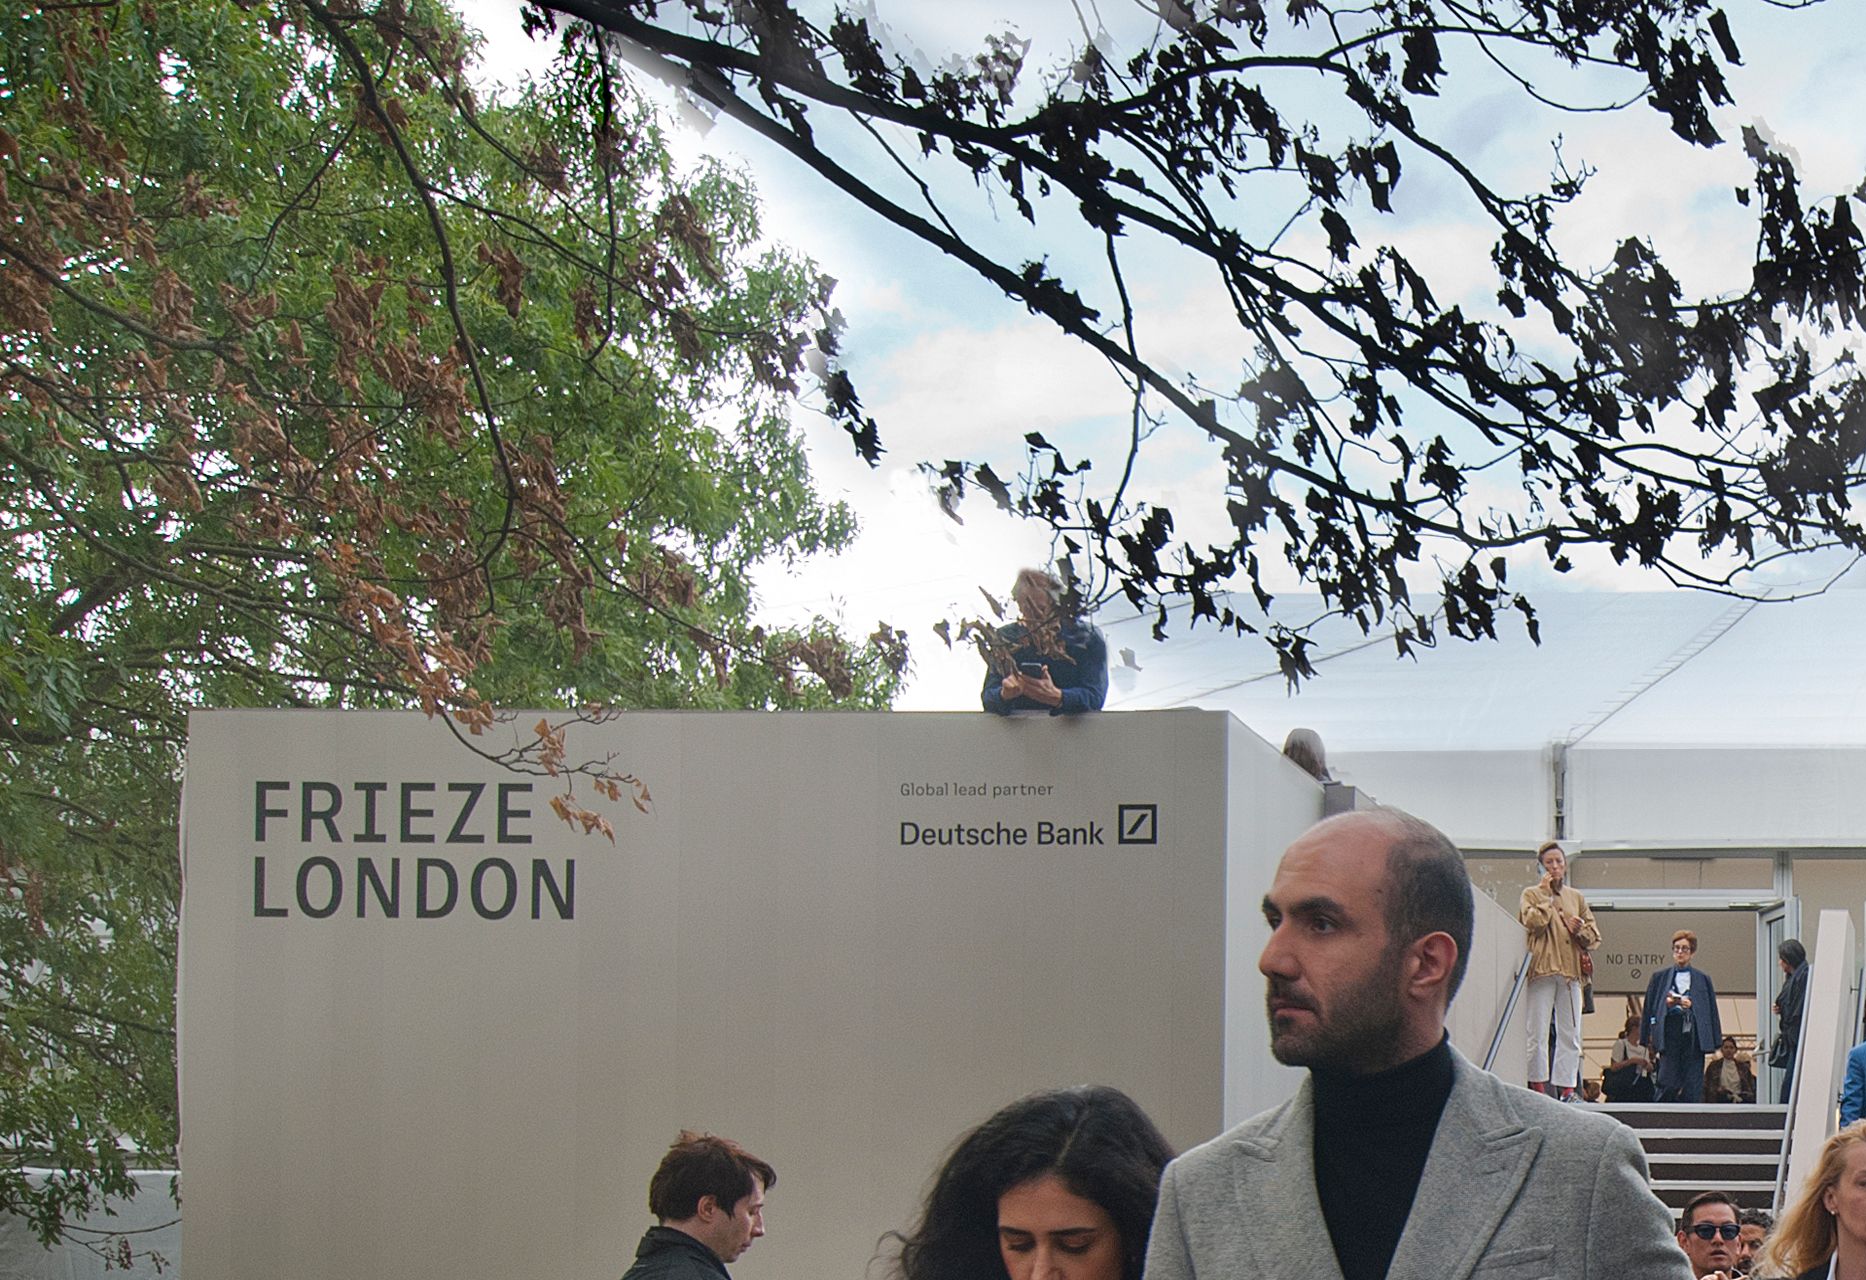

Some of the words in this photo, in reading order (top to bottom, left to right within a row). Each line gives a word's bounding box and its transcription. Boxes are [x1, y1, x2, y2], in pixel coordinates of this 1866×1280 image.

[900, 783, 949, 797] Global
[953, 783, 987, 797] lead
[992, 784, 1054, 799] partner
[254, 780, 534, 844] FRIEZE
[900, 821, 1028, 846] Deutsche
[1037, 821, 1104, 846] Bank
[254, 855, 576, 920] LONDON
[1606, 954, 1623, 965] NO
[1627, 954, 1665, 965] ENTRY
